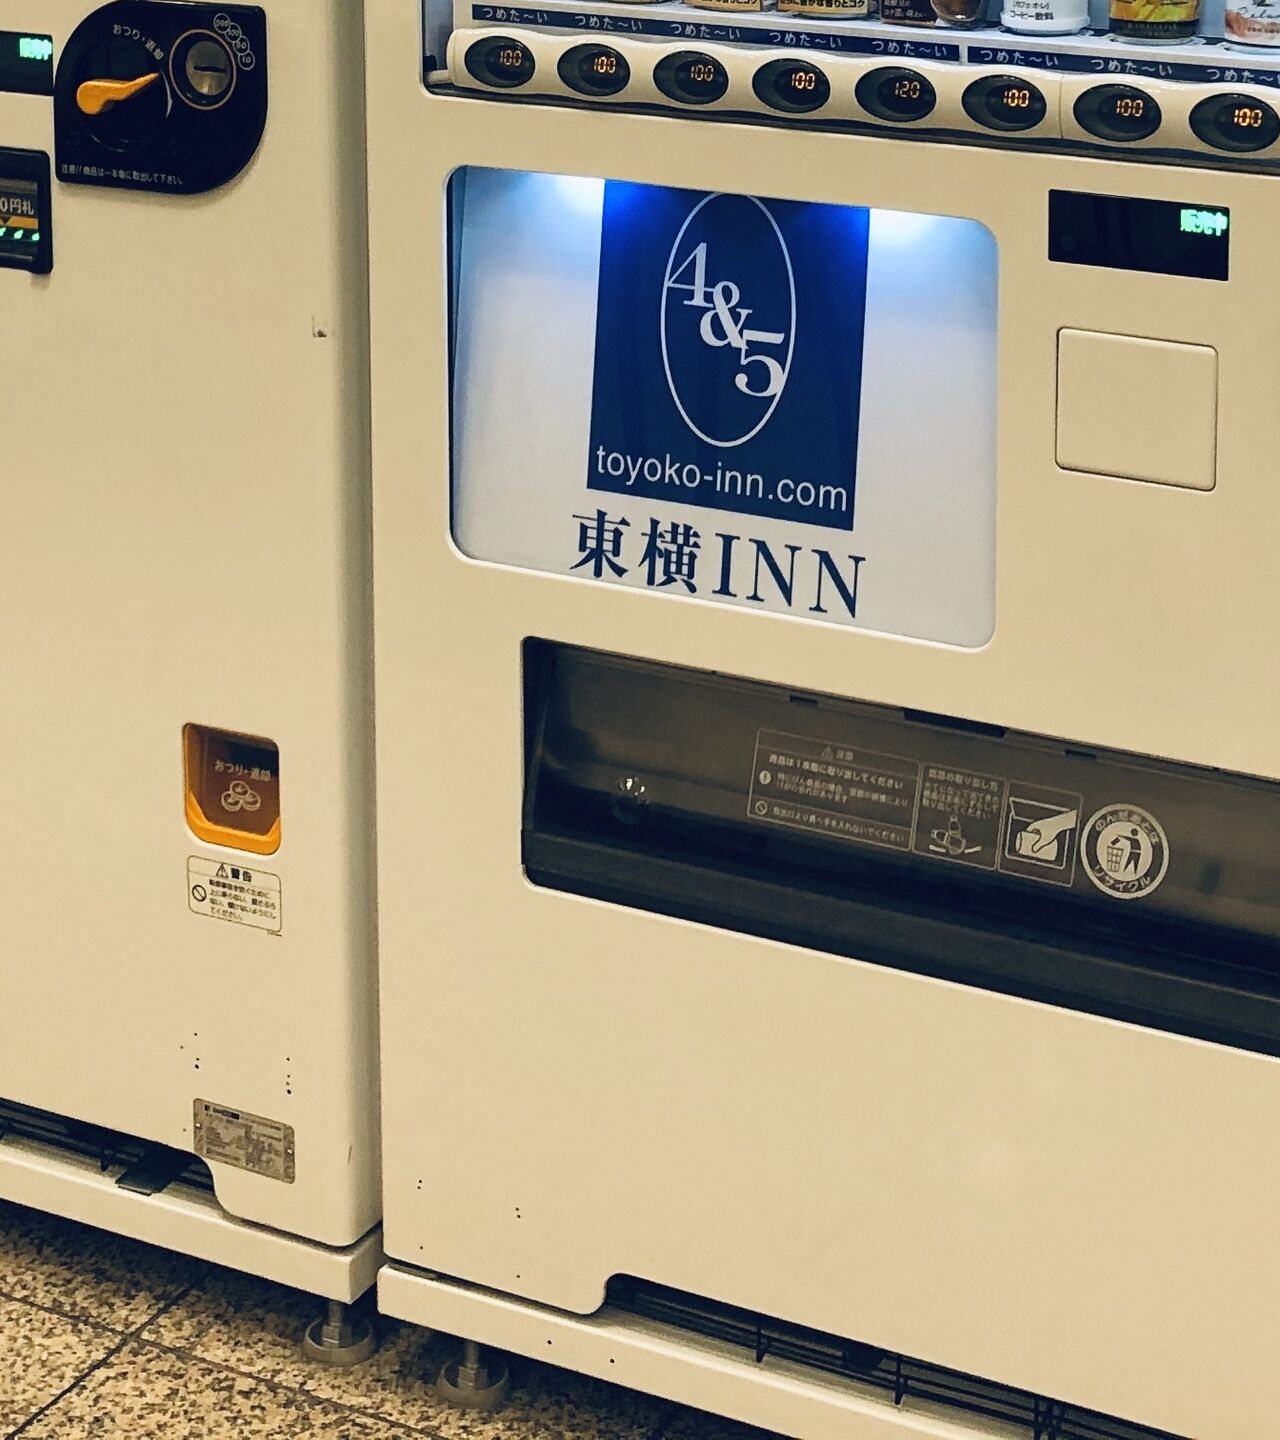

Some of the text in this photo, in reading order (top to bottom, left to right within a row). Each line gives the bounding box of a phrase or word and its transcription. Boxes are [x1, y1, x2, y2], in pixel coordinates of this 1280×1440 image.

[574, 14, 643, 30] つめた〜い
[1009, 9, 1054, 21] コーヒー飲料
[979, 49, 1059, 66] つめた〜い
[791, 71, 815, 90] 100
[1002, 90, 1029, 107] 100
[596, 445, 848, 512] toyoko-inn.com
[570, 508, 867, 619] 東横INN
[1095, 865, 1151, 892] リサイクル
